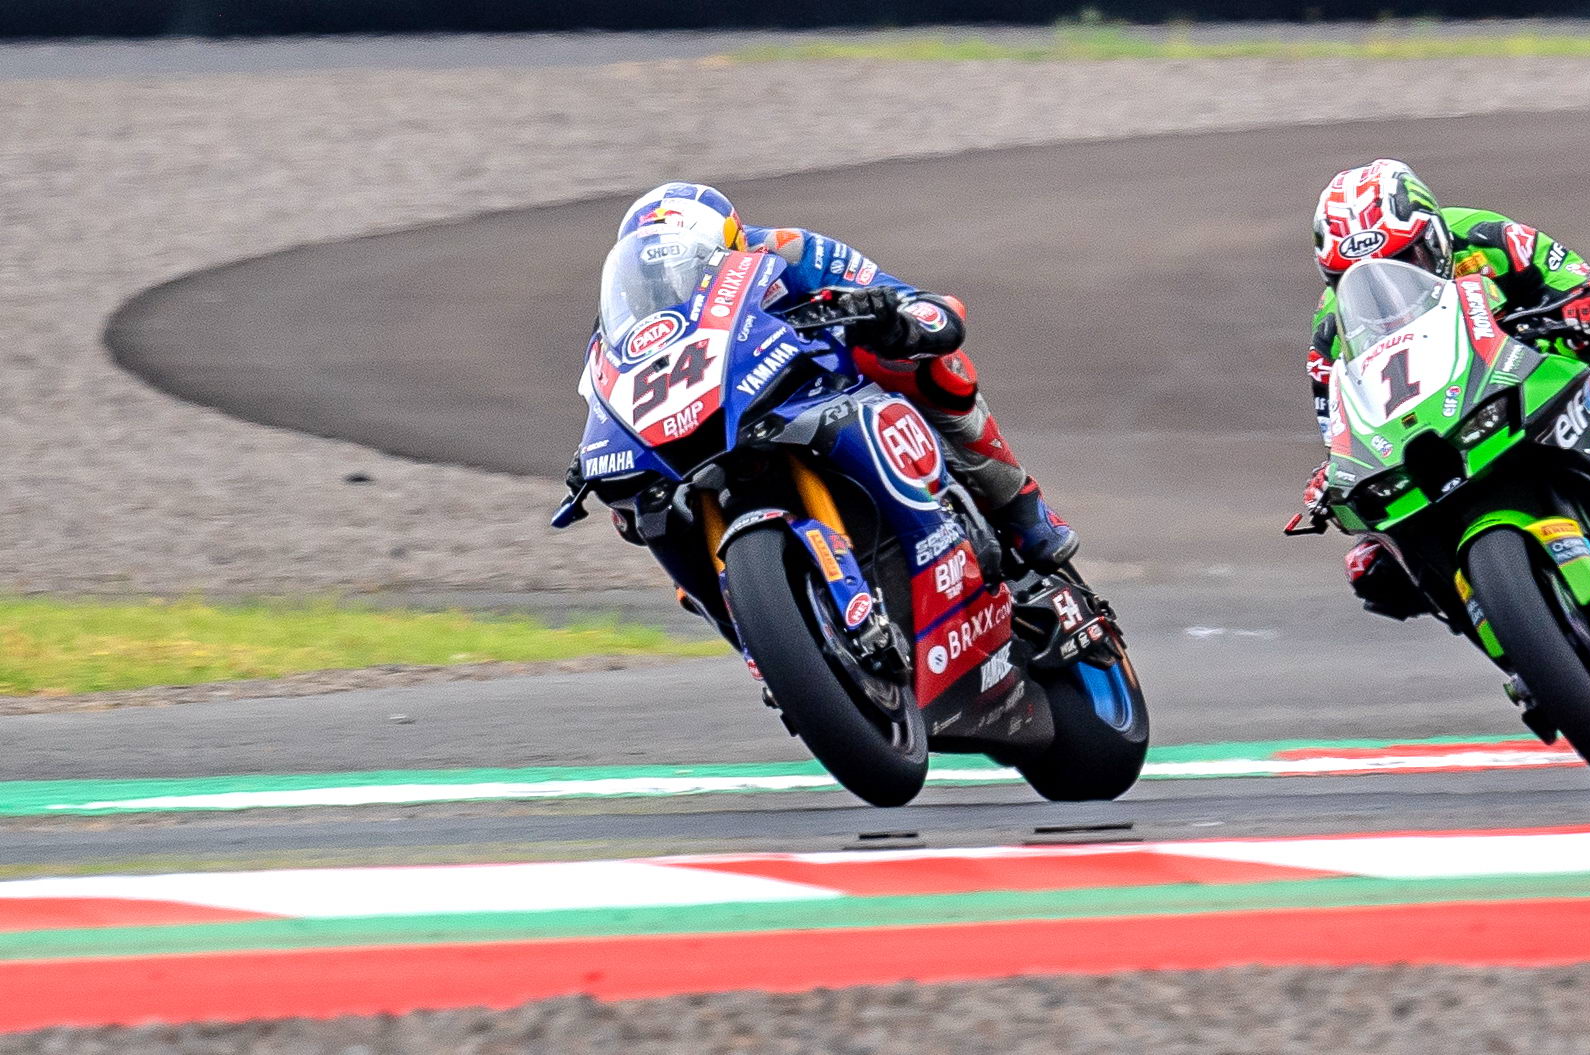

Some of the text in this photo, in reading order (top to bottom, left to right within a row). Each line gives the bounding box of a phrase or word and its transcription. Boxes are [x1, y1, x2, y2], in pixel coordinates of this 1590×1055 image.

[1345, 230, 1380, 253] Arai
[1547, 242, 1567, 271] elf
[633, 323, 670, 352] PATA
[632, 338, 718, 426] 54
[736, 342, 800, 396] YAMAHA
[1380, 348, 1421, 420] 1
[662, 400, 704, 437] BMP
[1556, 389, 1589, 450] elf
[584, 449, 636, 477] YAMAHA
[935, 549, 967, 593] BMP
